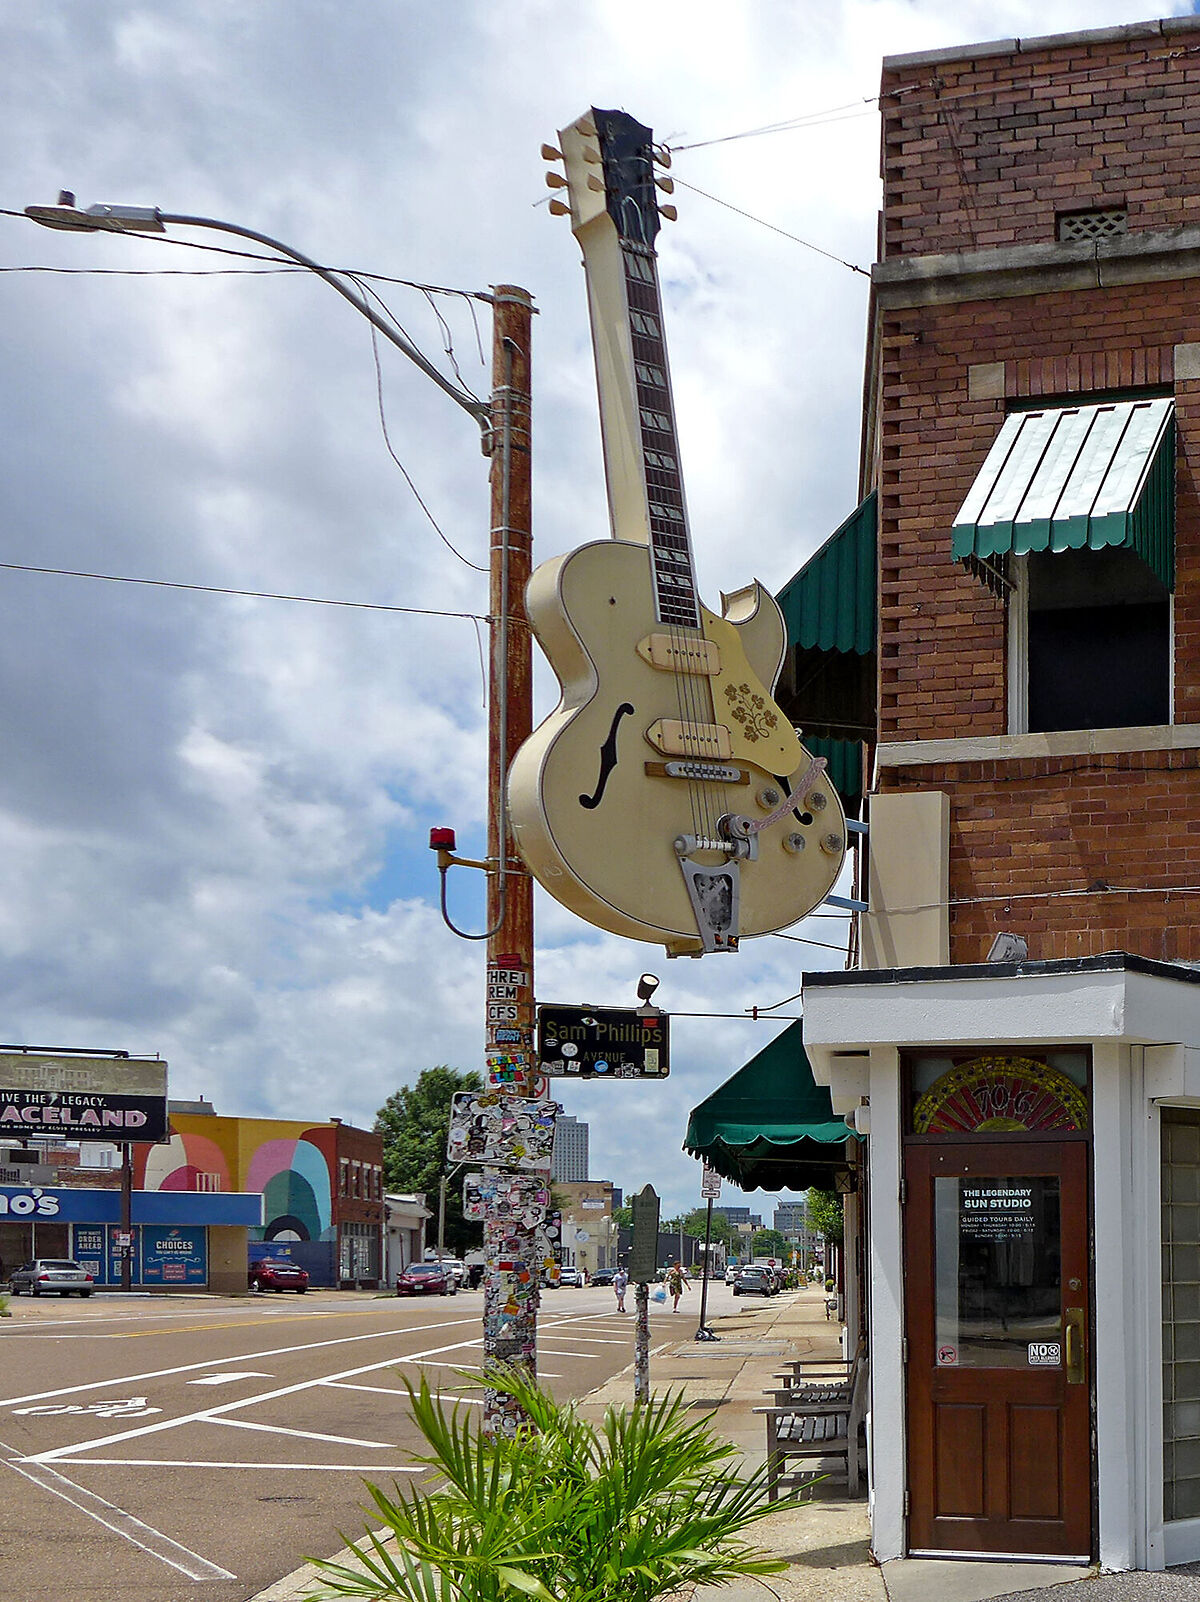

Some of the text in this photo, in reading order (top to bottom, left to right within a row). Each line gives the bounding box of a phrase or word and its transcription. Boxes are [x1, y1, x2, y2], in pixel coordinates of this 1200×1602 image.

[489, 986, 517, 999] REM
[489, 1006, 517, 1019] CFS
[546, 1021, 586, 1040] Sam
[596, 1023, 662, 1047] Phillips
[583, 1051, 627, 1063] AVENUE
[25, 1093, 46, 1104] THE
[62, 1095, 108, 1107] LEGACY.
[972, 1084, 1038, 1115] 706
[0, 1105, 148, 1127] ACELAND
[963, 1189, 1032, 1197] THE LEGENDARY
[964, 1199, 1032, 1208] SUN STUDIO
[156, 1241, 193, 1250] CHOICES
[1030, 1345, 1048, 1356] NO
